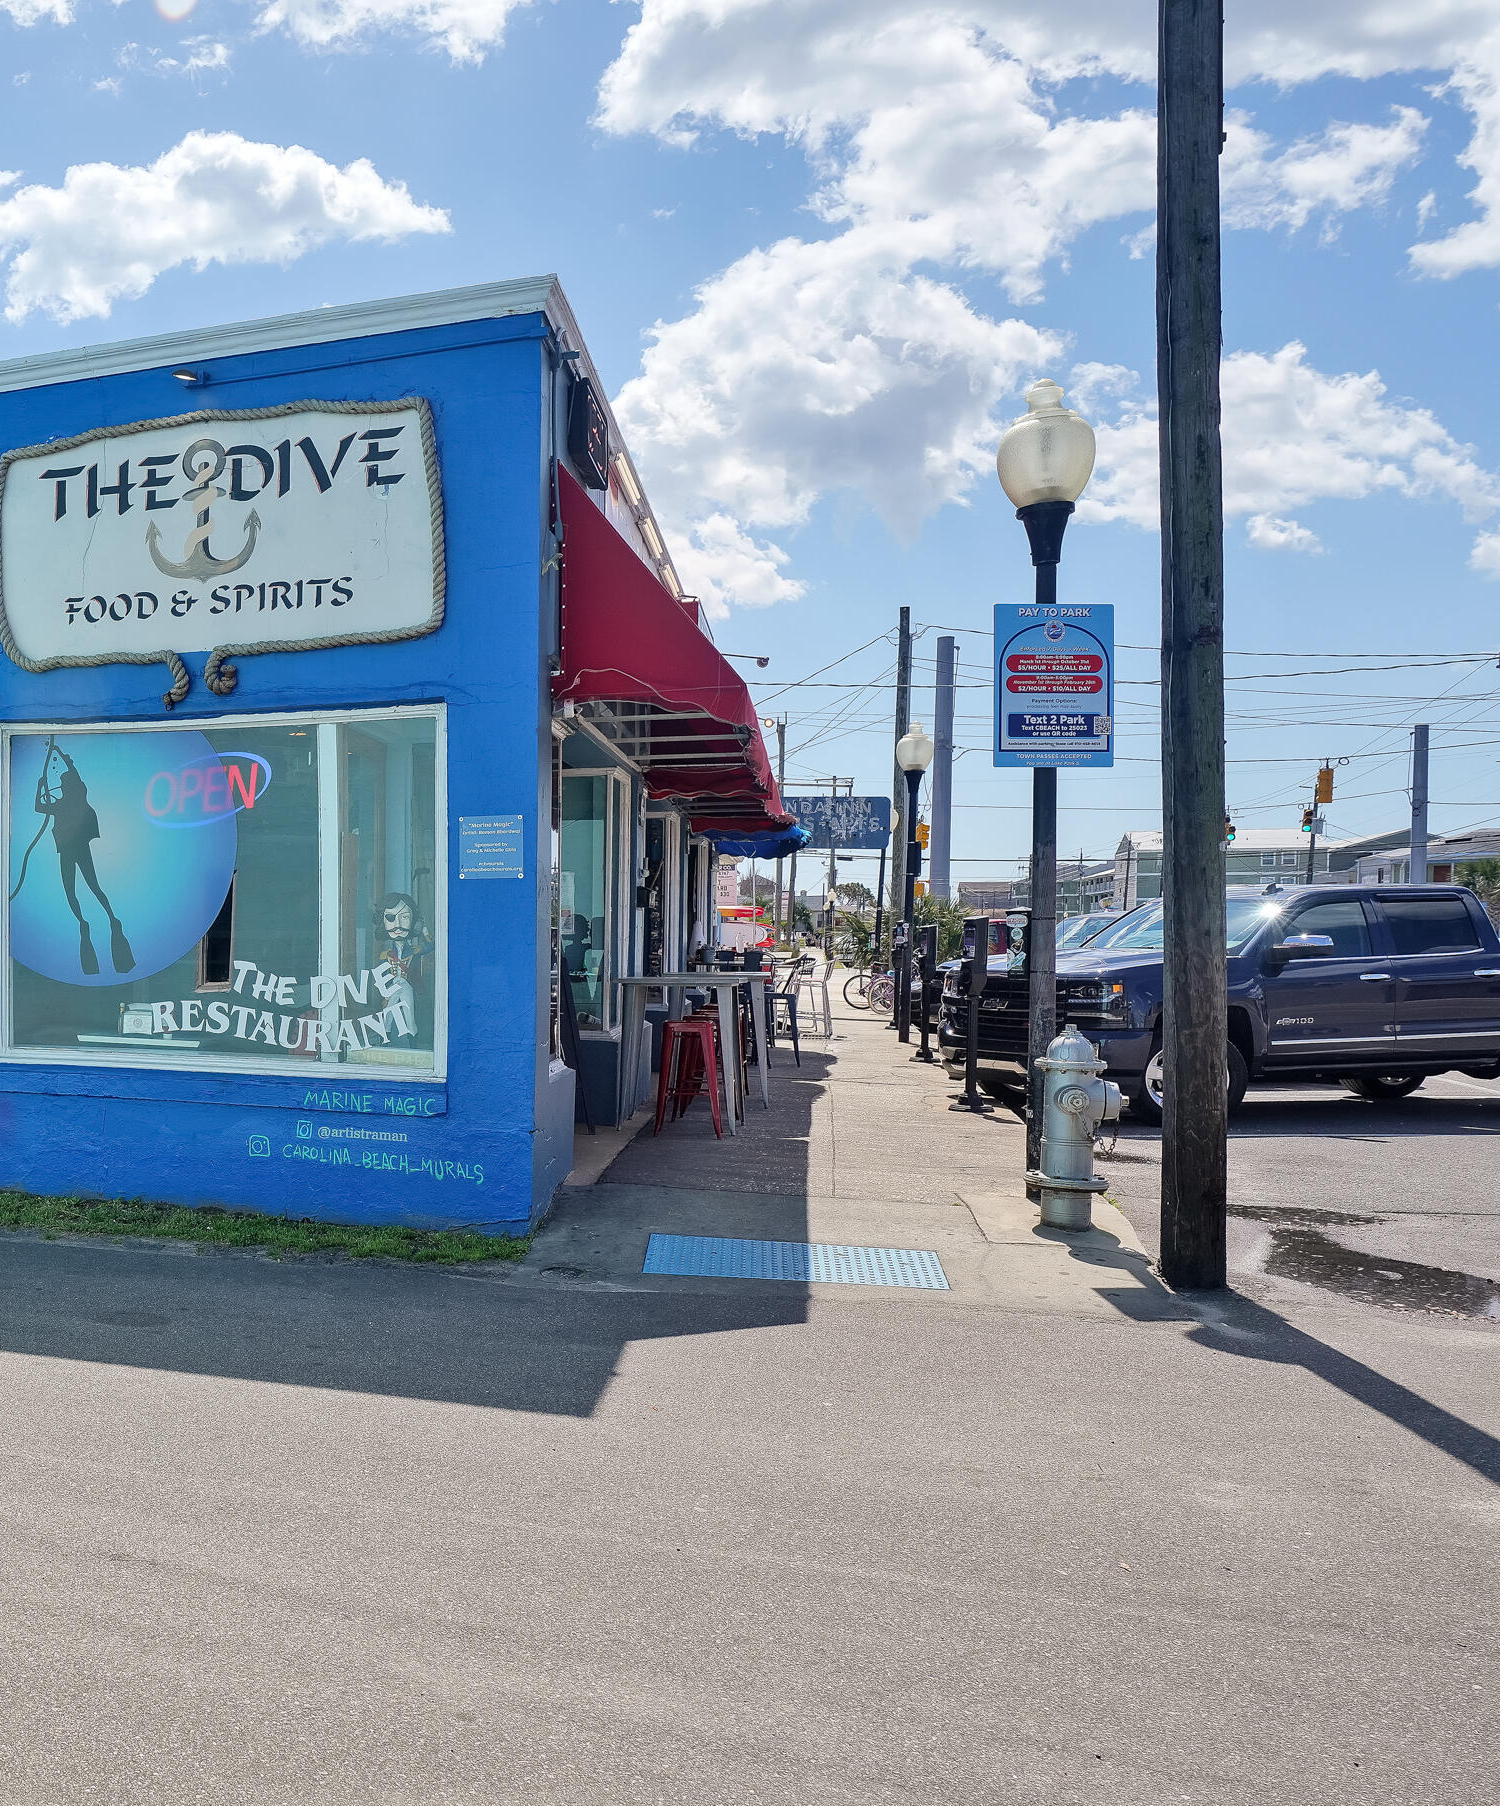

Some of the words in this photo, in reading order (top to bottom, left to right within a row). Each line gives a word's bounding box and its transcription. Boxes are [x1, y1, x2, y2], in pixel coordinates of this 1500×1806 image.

[39, 453, 181, 522] THE
[225, 425, 406, 502] DIVE
[65, 590, 159, 626] FOOD
[169, 589, 199, 618] &
[209, 576, 355, 616] SPIRITS
[1018, 607, 1040, 617] PAY
[1042, 607, 1058, 617] TO
[1060, 607, 1092, 617] PARK
[1023, 715, 1048, 725] Text
[1050, 715, 1057, 725] 2
[1060, 715, 1085, 725] Park
[144, 763, 258, 816] OPEN
[233, 960, 298, 1006] THE
[310, 961, 403, 1009] DIVE
[150, 999, 416, 1054] RESTAURANT
[304, 1090, 373, 1113] MARINE
[384, 1097, 436, 1116] MAGIC
[317, 1126, 408, 1143] @artistraman
